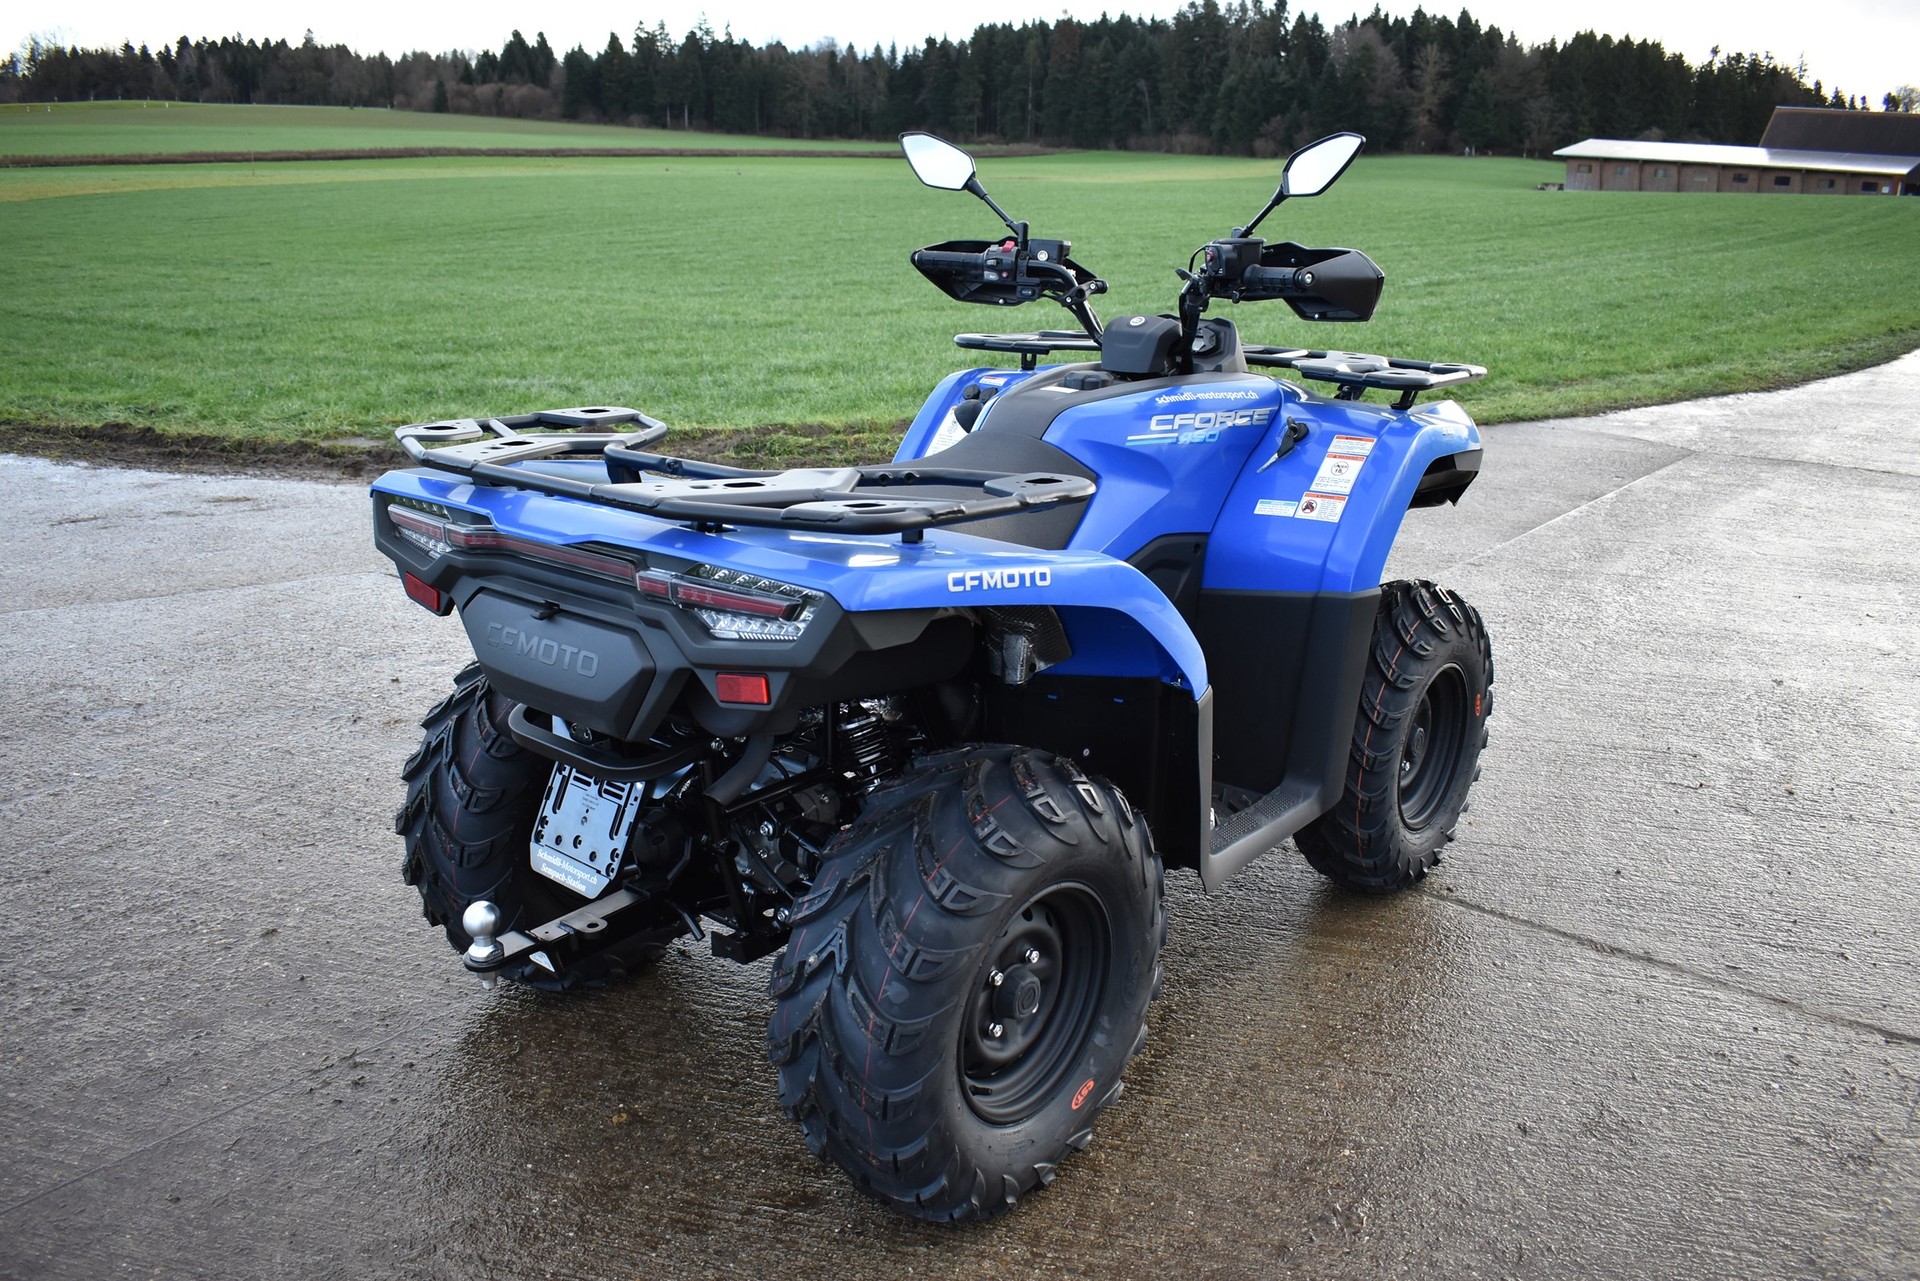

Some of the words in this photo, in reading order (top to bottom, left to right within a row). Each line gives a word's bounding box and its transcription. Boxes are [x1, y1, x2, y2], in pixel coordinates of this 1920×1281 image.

[1155, 390, 1260, 405] schmidli-motorsport.ch
[1149, 408, 1271, 431] CFORCE
[946, 565, 1052, 593] CFMOTO
[487, 621, 600, 679] CFMOTO
